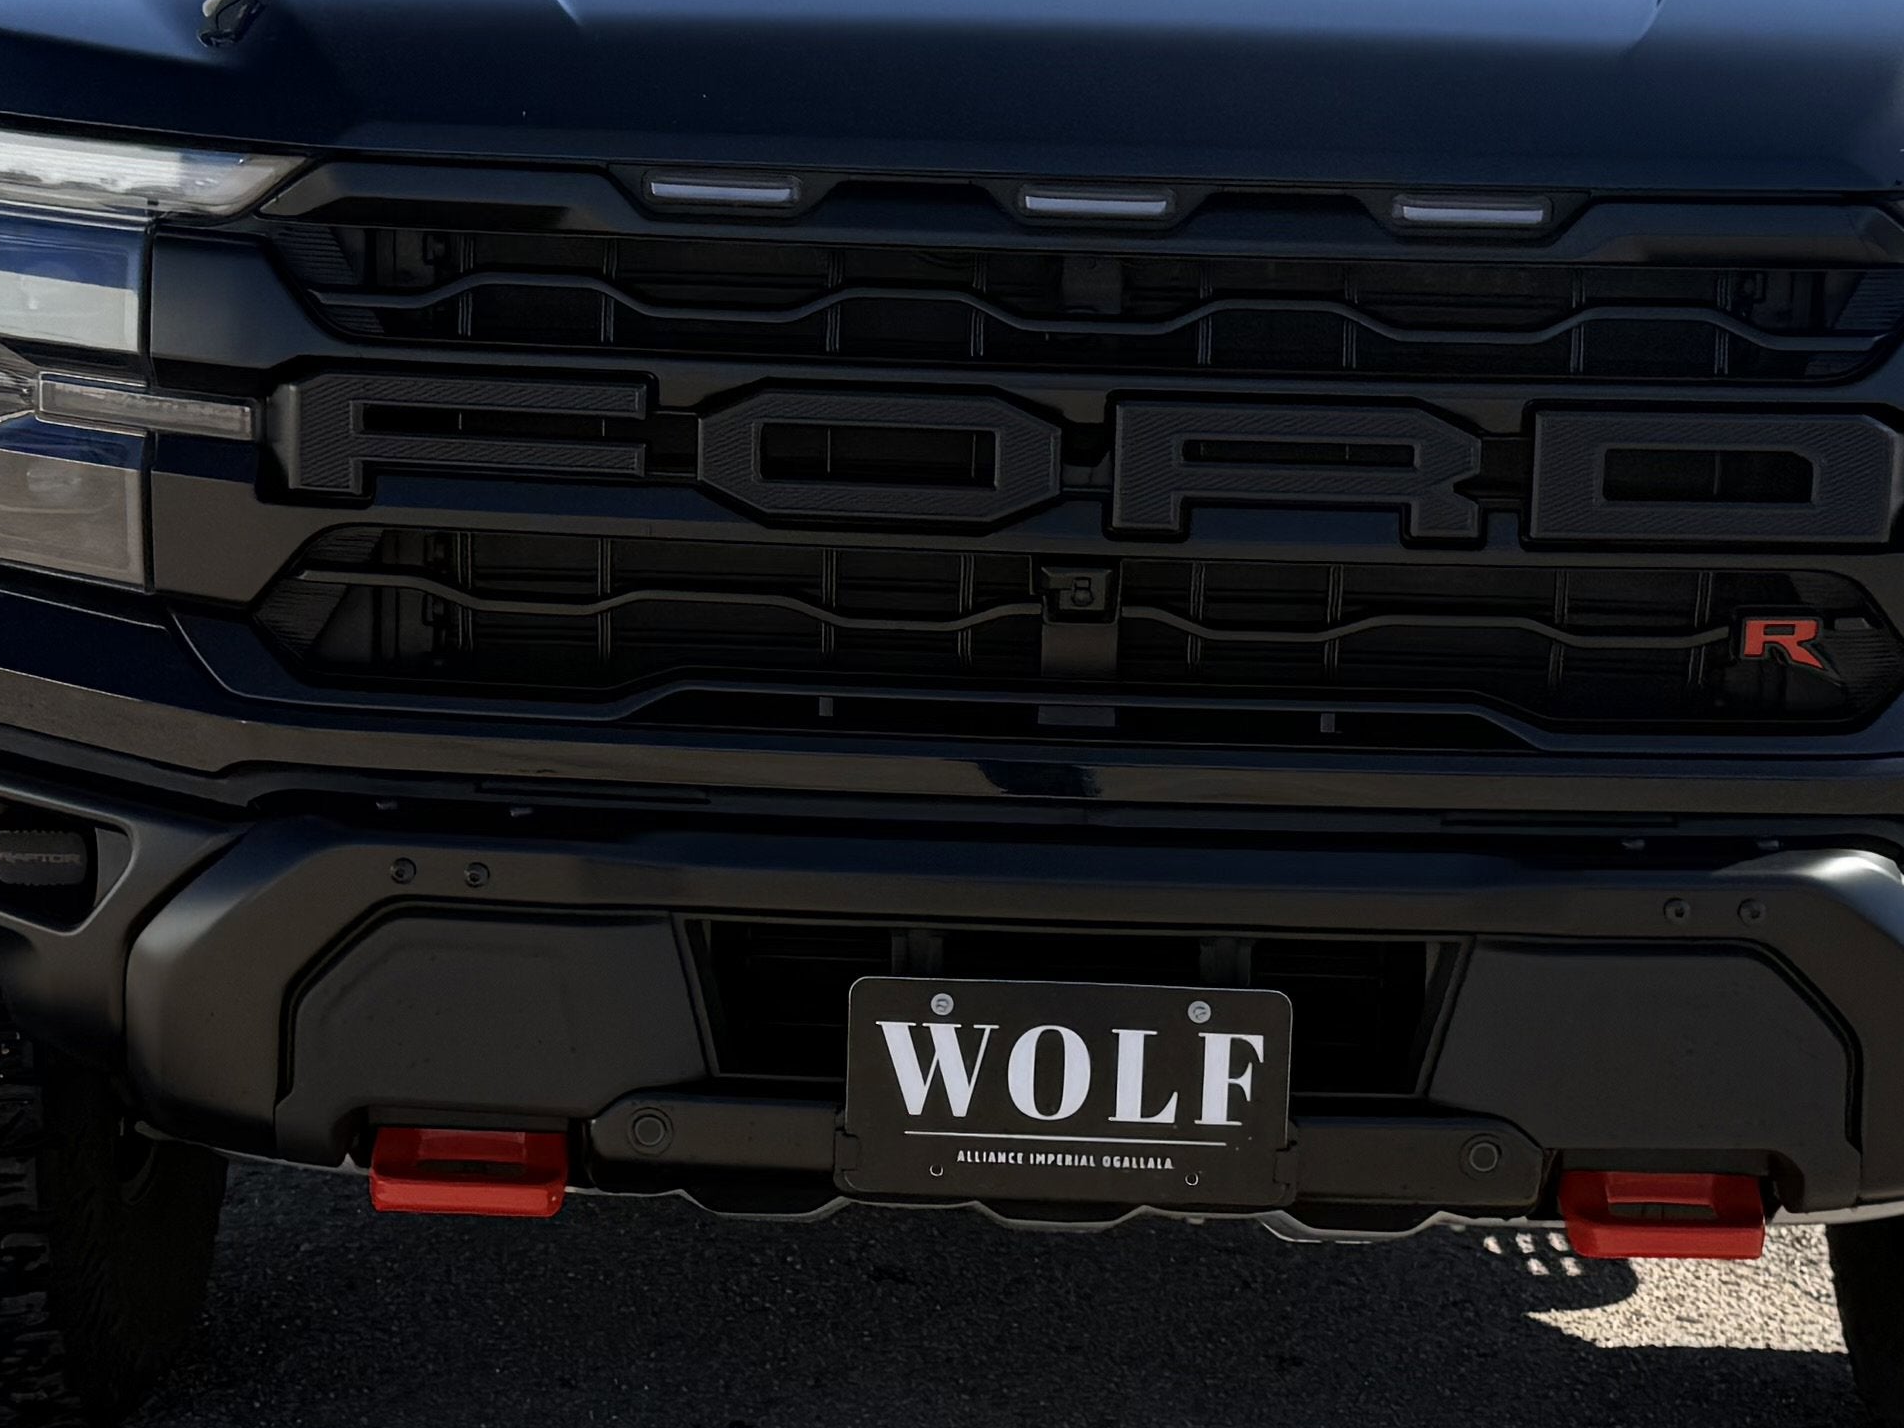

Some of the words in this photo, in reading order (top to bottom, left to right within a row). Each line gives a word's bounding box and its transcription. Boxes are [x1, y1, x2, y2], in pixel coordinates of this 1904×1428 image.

[1743, 619, 1828, 672] R
[876, 1020, 1265, 1127] WOLF
[956, 1150, 1024, 1165] ALLIANCE
[1029, 1152, 1096, 1167] IMPERIAL
[1102, 1155, 1175, 1169] OGALLALA
